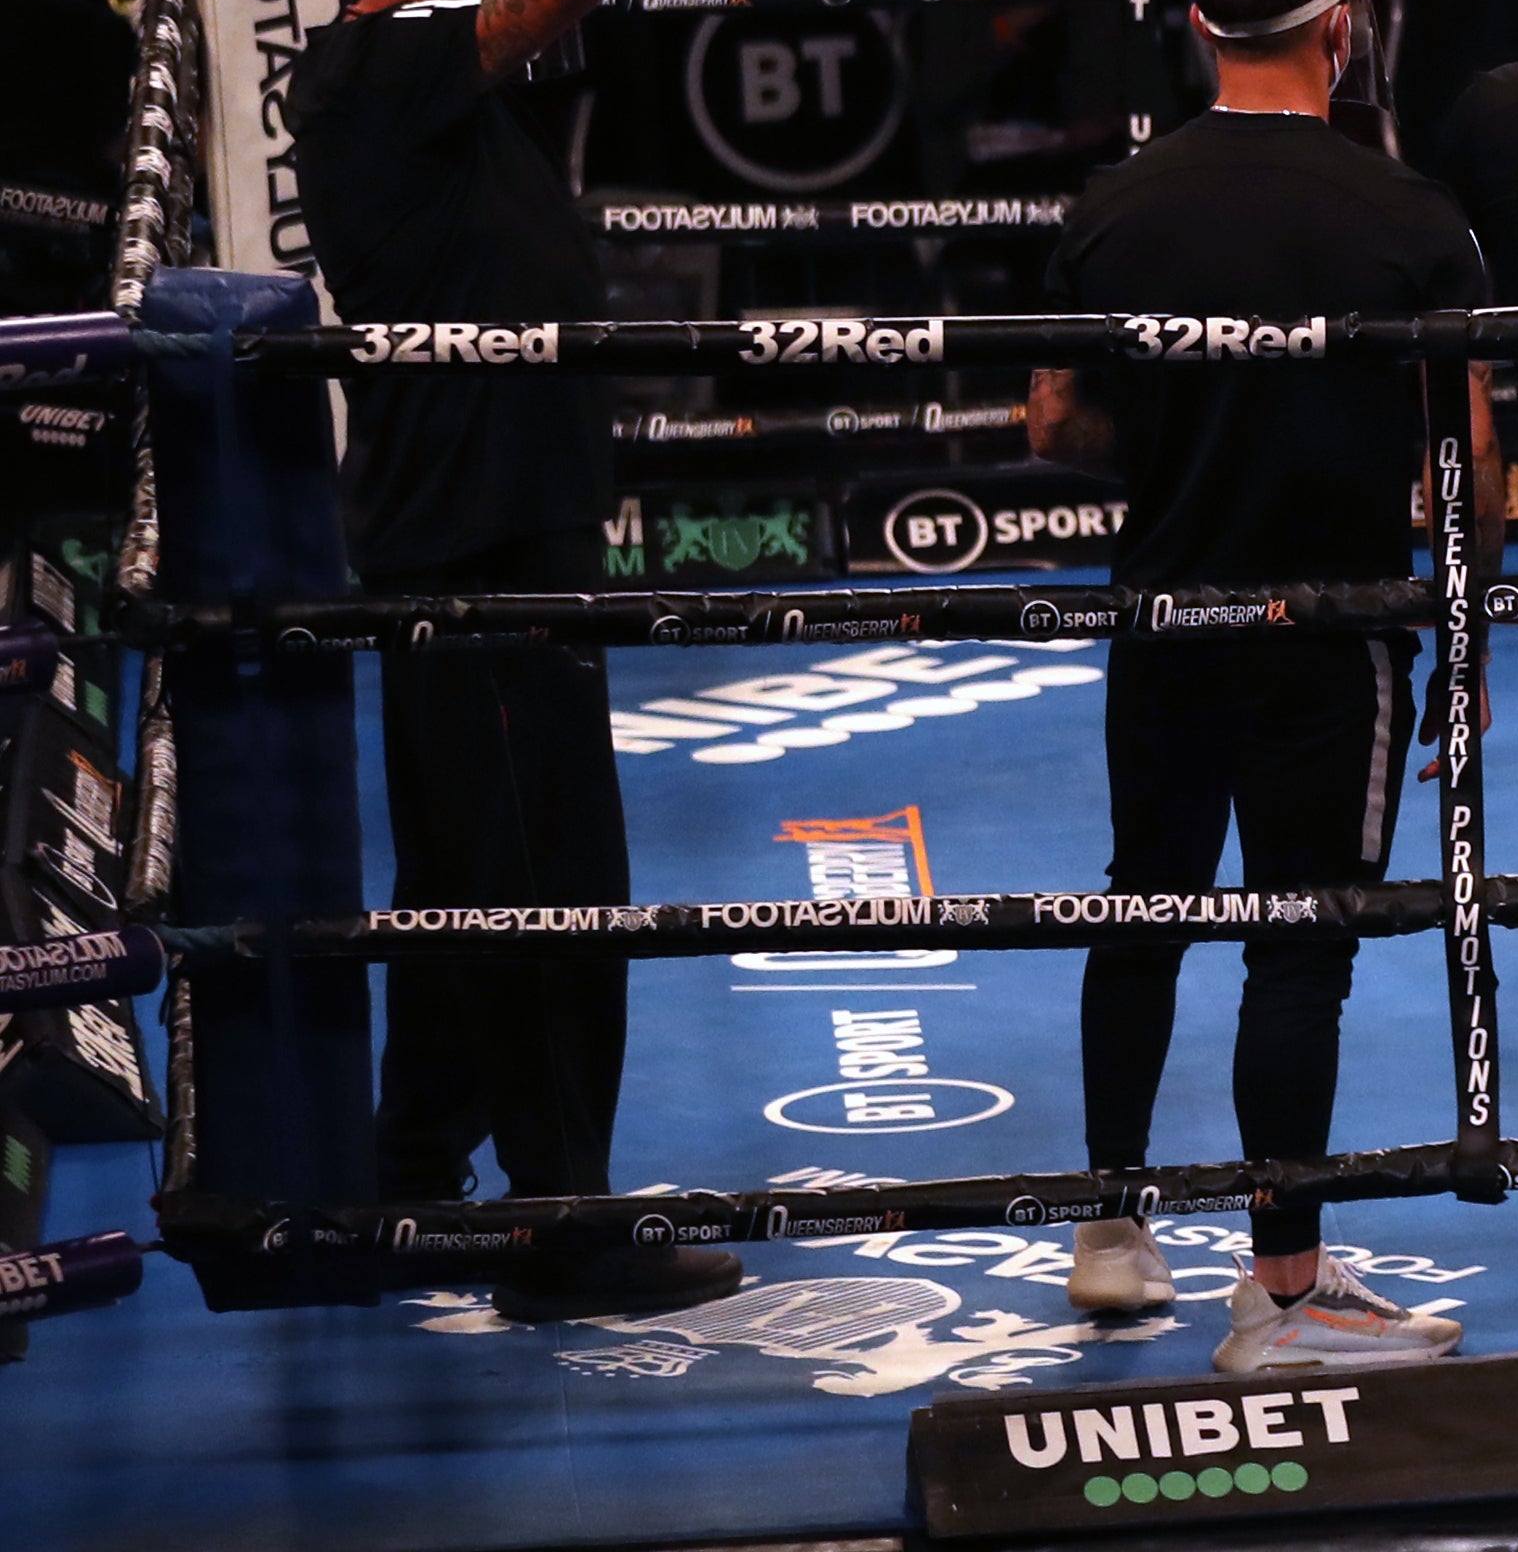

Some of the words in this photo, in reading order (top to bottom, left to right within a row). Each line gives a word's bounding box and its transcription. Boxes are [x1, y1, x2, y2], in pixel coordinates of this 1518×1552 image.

[739, 37, 855, 123] BT
[604, 205, 777, 232] FOOTASYLUM
[852, 200, 1022, 229] FOOTASYLUM
[350, 323, 559, 364] 32Red
[738, 319, 945, 365] 32Red
[1124, 315, 1326, 362] 32Red
[860, 412, 901, 430] SPORT
[906, 513, 962, 549] BT
[994, 500, 1130, 544] SPORT
[692, 623, 749, 642] SPORT
[783, 608, 899, 642] QUEENSBERRY
[1063, 610, 1119, 628] SPORT
[1151, 593, 1266, 633] QUEENSBERRY
[1437, 437, 1470, 789] QUEENSBERRY
[369, 906, 600, 935] FOOTASYLUM
[701, 898, 932, 929] FOOTASYLUM
[1033, 892, 1260, 925] FOOTASYLUM
[1450, 805, 1492, 1127] PROMOTIONS
[830, 1009, 930, 1079] SPORT
[844, 1093, 936, 1123] BT
[1049, 1203, 1104, 1220] SPORT
[1137, 1185, 1254, 1217] QUEENSBERRY
[677, 1224, 733, 1242] SPORT
[766, 1205, 883, 1240] QUEENSBERRY
[0, 1252, 64, 1293] BET
[1004, 1386, 1360, 1469] UNIBET
